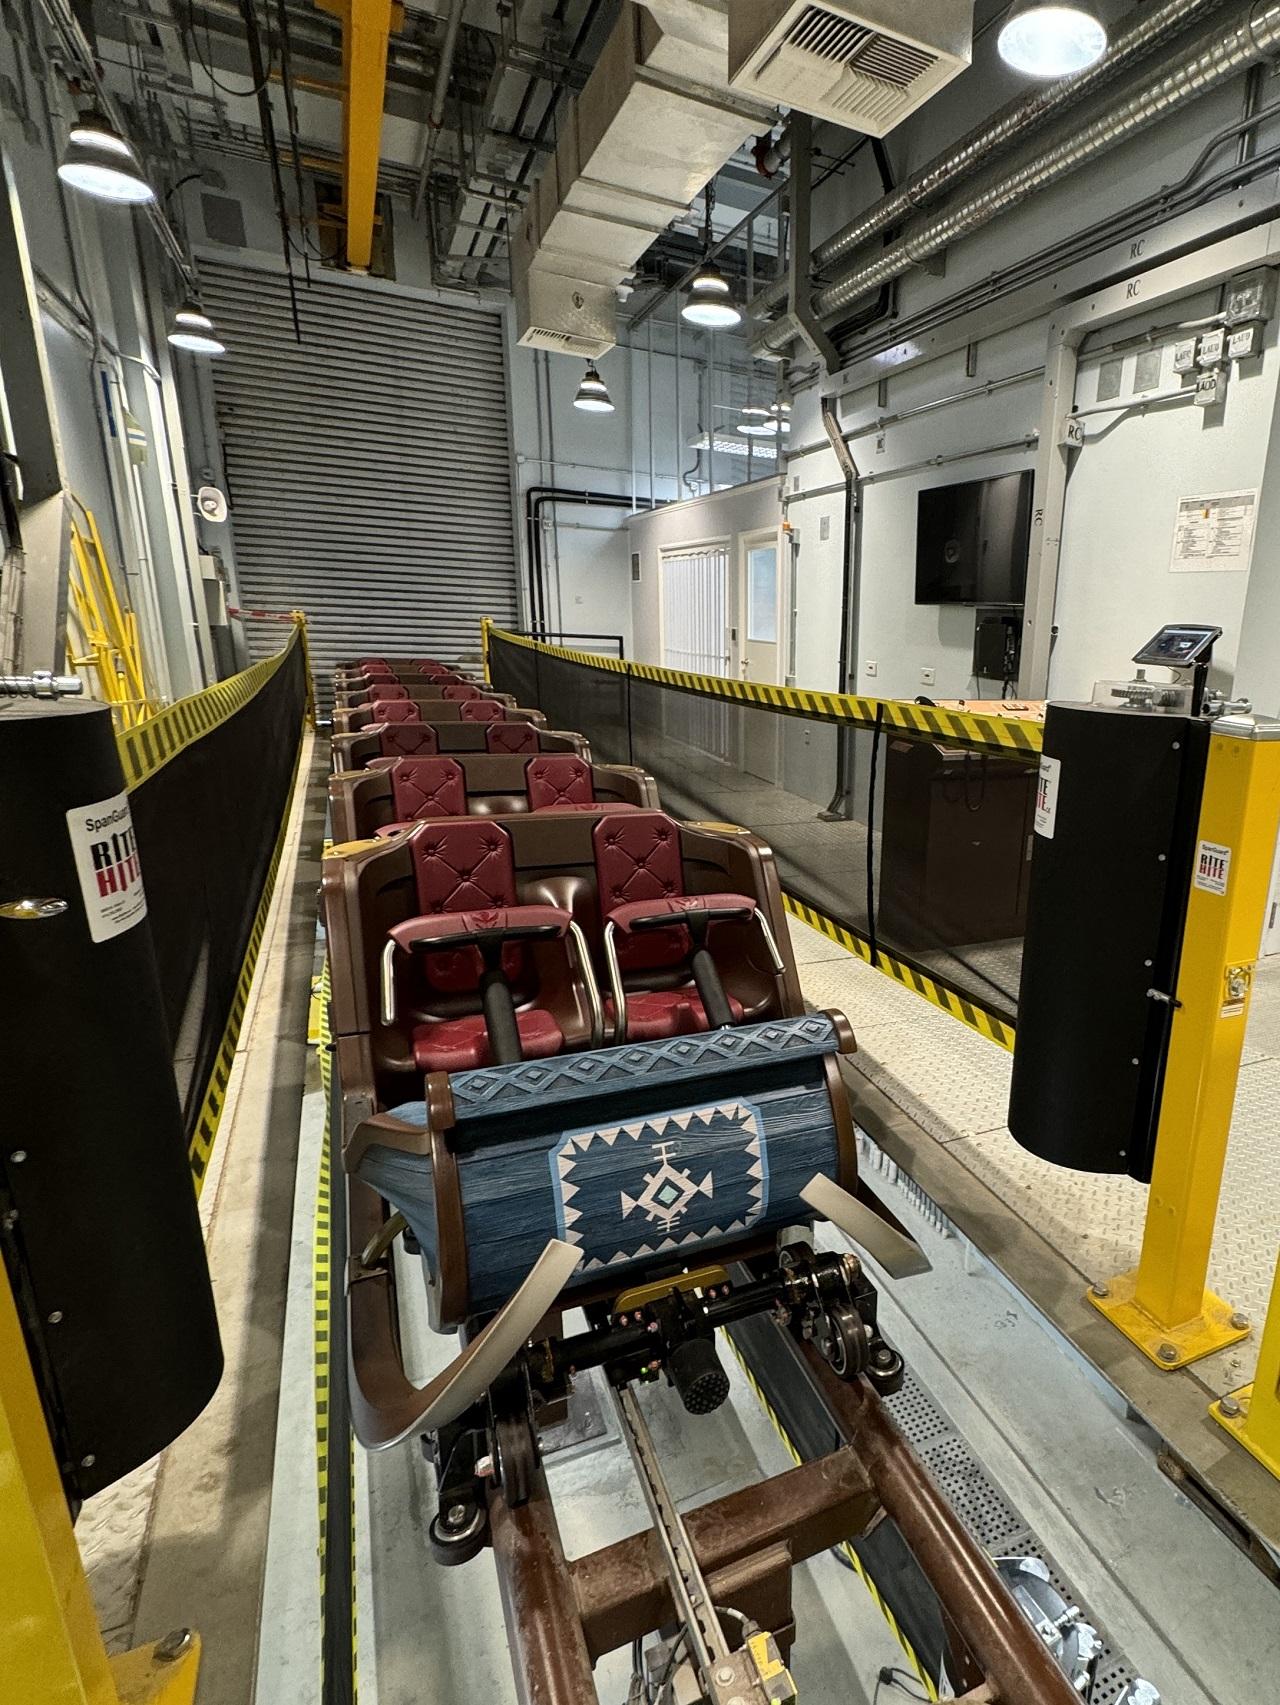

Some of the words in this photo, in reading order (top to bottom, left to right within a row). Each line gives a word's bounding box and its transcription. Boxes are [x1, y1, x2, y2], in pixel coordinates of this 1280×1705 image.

[1130, 239, 1145, 260] RC
[1126, 279, 1141, 299] RC
[1068, 424, 1081, 441] RC
[1034, 508, 1043, 527] RC
[85, 806, 129, 833] SpanGuar
[1200, 853, 1225, 870] RITE
[1199, 863, 1225, 880] HITE
